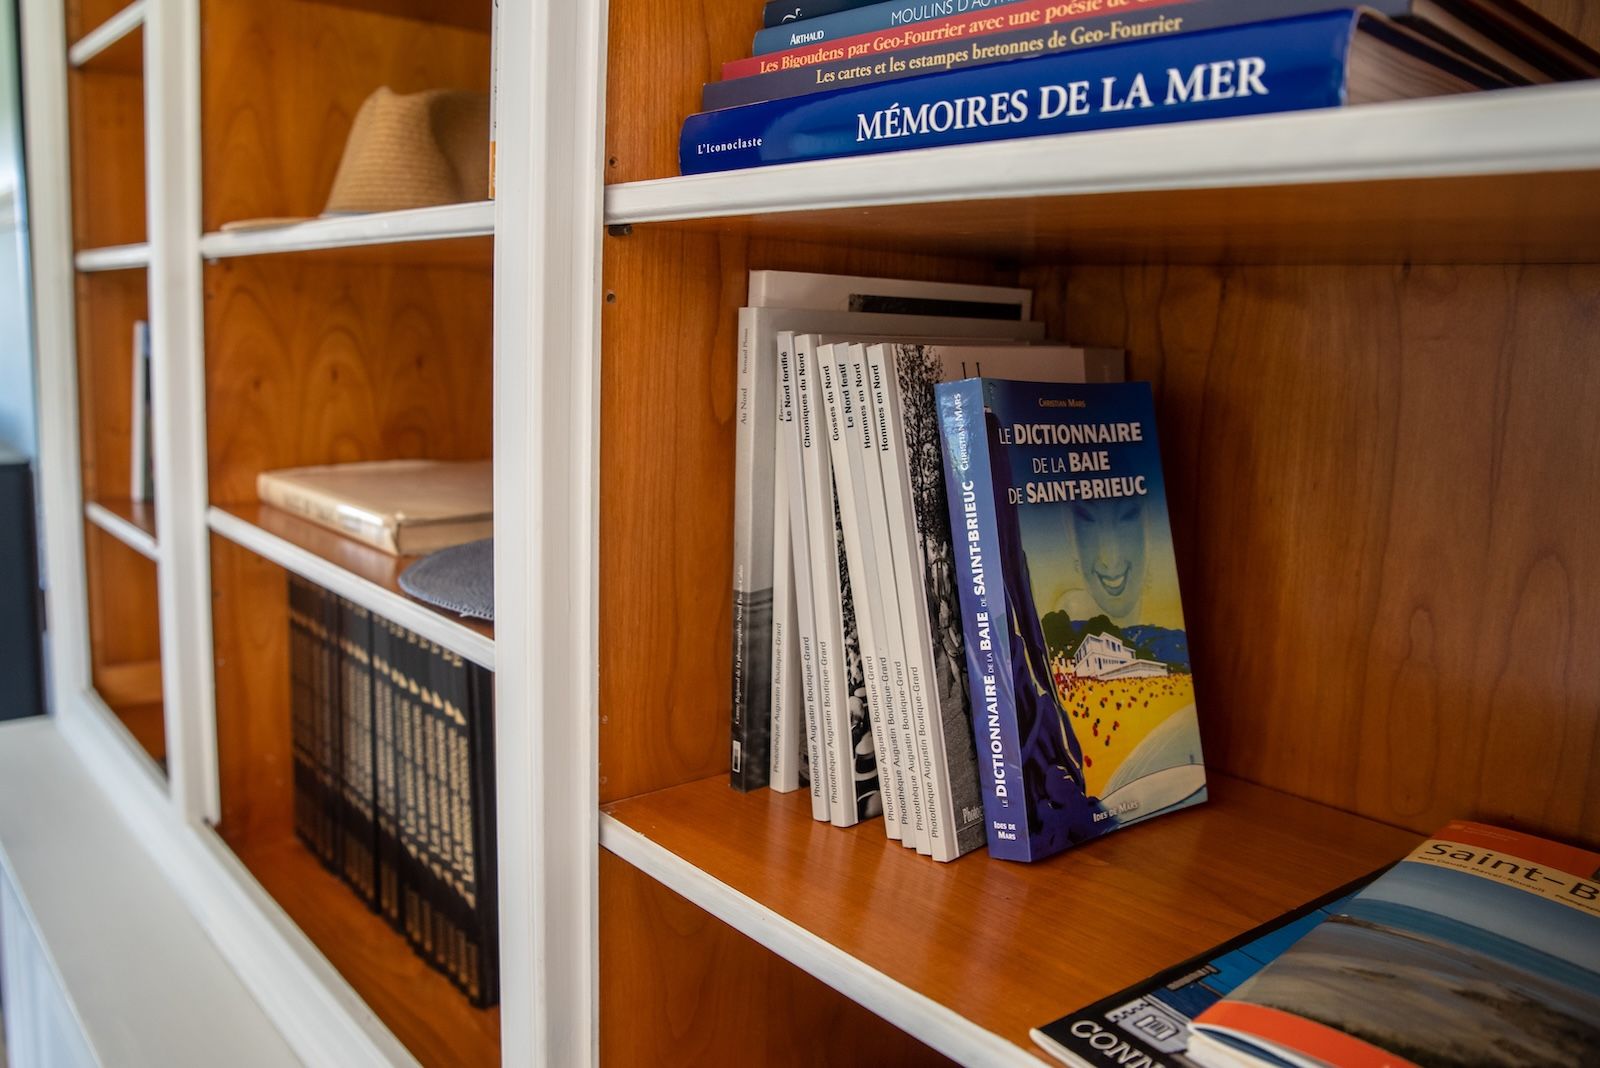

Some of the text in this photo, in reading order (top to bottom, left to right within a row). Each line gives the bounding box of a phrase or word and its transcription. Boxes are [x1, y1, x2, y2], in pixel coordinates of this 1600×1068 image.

[760, 60, 779, 74] Les
[780, 47, 844, 70] Bigoudens
[847, 41, 871, 59] par
[873, 23, 966, 51] Geo-Fourrier
[968, 16, 1004, 34] avec
[1008, 9, 1041, 26] une
[891, 0, 953, 25] MOULINS
[815, 15, 1183, 84] Les cartes et les estampes bretonnes de Geo-Fourrier
[856, 56, 1270, 142] MÉMOIRES DE LA MER
[783, 384, 791, 408] Nord
[785, 411, 792, 422] Le
[797, 353, 811, 448] Chroniques du Nord
[822, 365, 840, 441] Gosses du Nord
[838, 363, 855, 428] Le Nord festif
[853, 363, 871, 449] Hommes en Nord
[871, 364, 889, 452] Hommes en Nord
[998, 422, 1143, 445] LE DICTIONNAIRE
[1032, 451, 1111, 474] DE LA BAIE
[1007, 475, 1148, 505] DE SAINT-BRIEUC
[803, 637, 814, 702] Boutique-Grard
[820, 642, 831, 707] Boutique-Grard
[962, 480, 1009, 808] LE DICTIONNAIRE DE LA BAIE DE SAINT-BRIEUC
[866, 656, 881, 723] Boutique-Grard
[880, 657, 895, 725] Boutique-Grard
[895, 661, 910, 730] Boutique-Grard
[911, 666, 926, 736] Boutique-Grard
[807, 705, 817, 742] Augustin
[823, 711, 834, 748] Augustin
[875, 726, 887, 764] Augustin
[888, 728, 901, 767] Augustin
[904, 733, 916, 772] Augustin
[920, 739, 932, 779] Augustin
